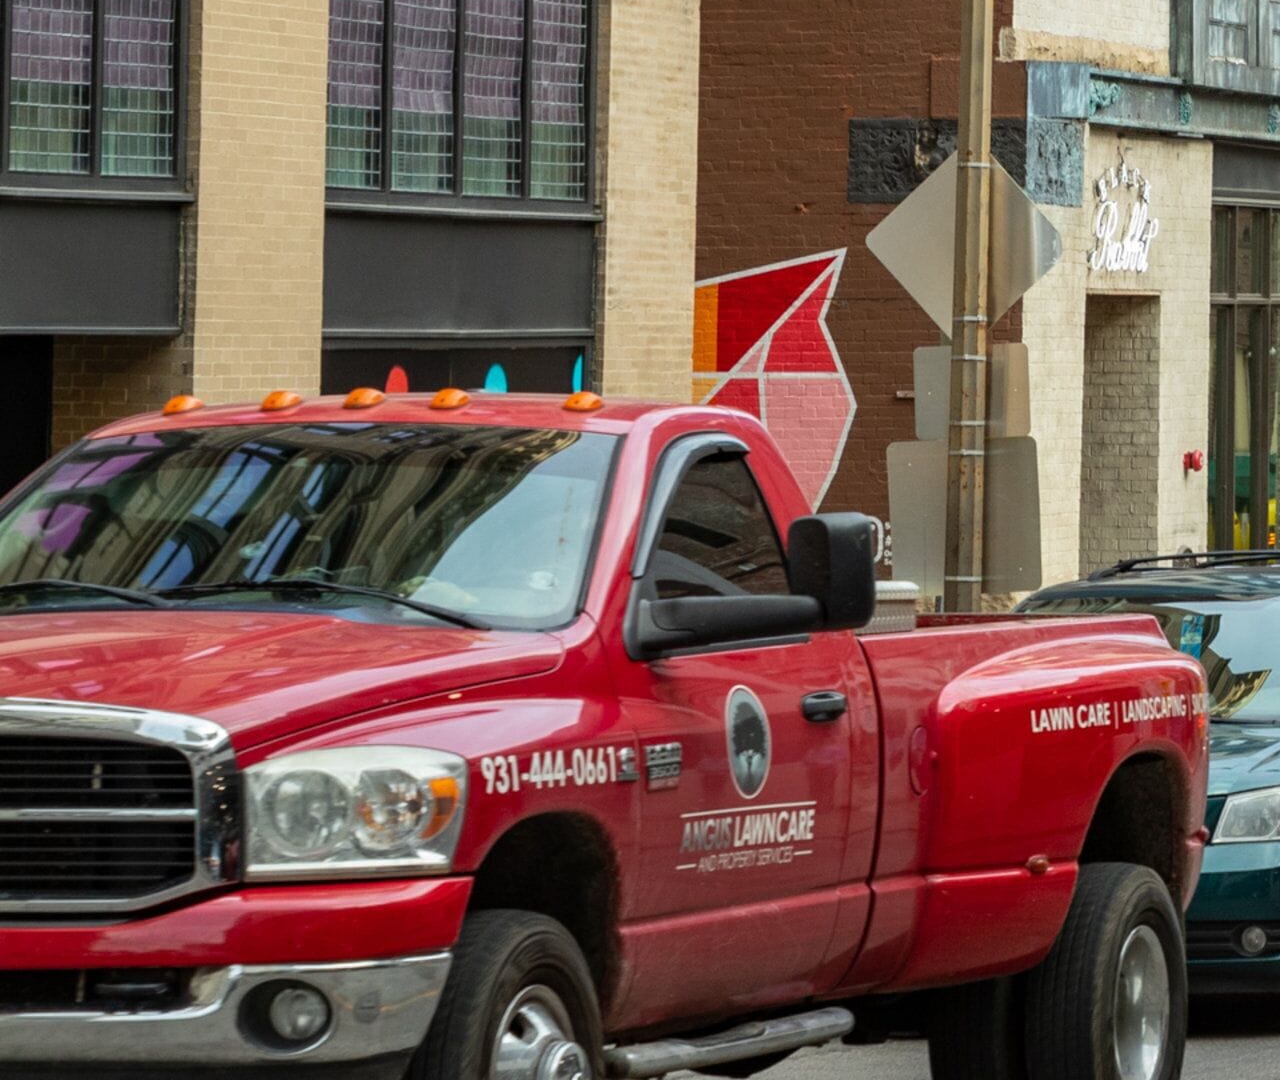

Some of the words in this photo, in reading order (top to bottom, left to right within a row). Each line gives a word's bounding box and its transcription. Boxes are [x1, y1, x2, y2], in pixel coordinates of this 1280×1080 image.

[1030, 706, 1074, 734] LAWN
[1076, 701, 1112, 729] CARE
[1122, 694, 1187, 724] LANDSCAPING
[480, 745, 617, 795] 931-444-0661
[680, 817, 733, 853] ANGUS
